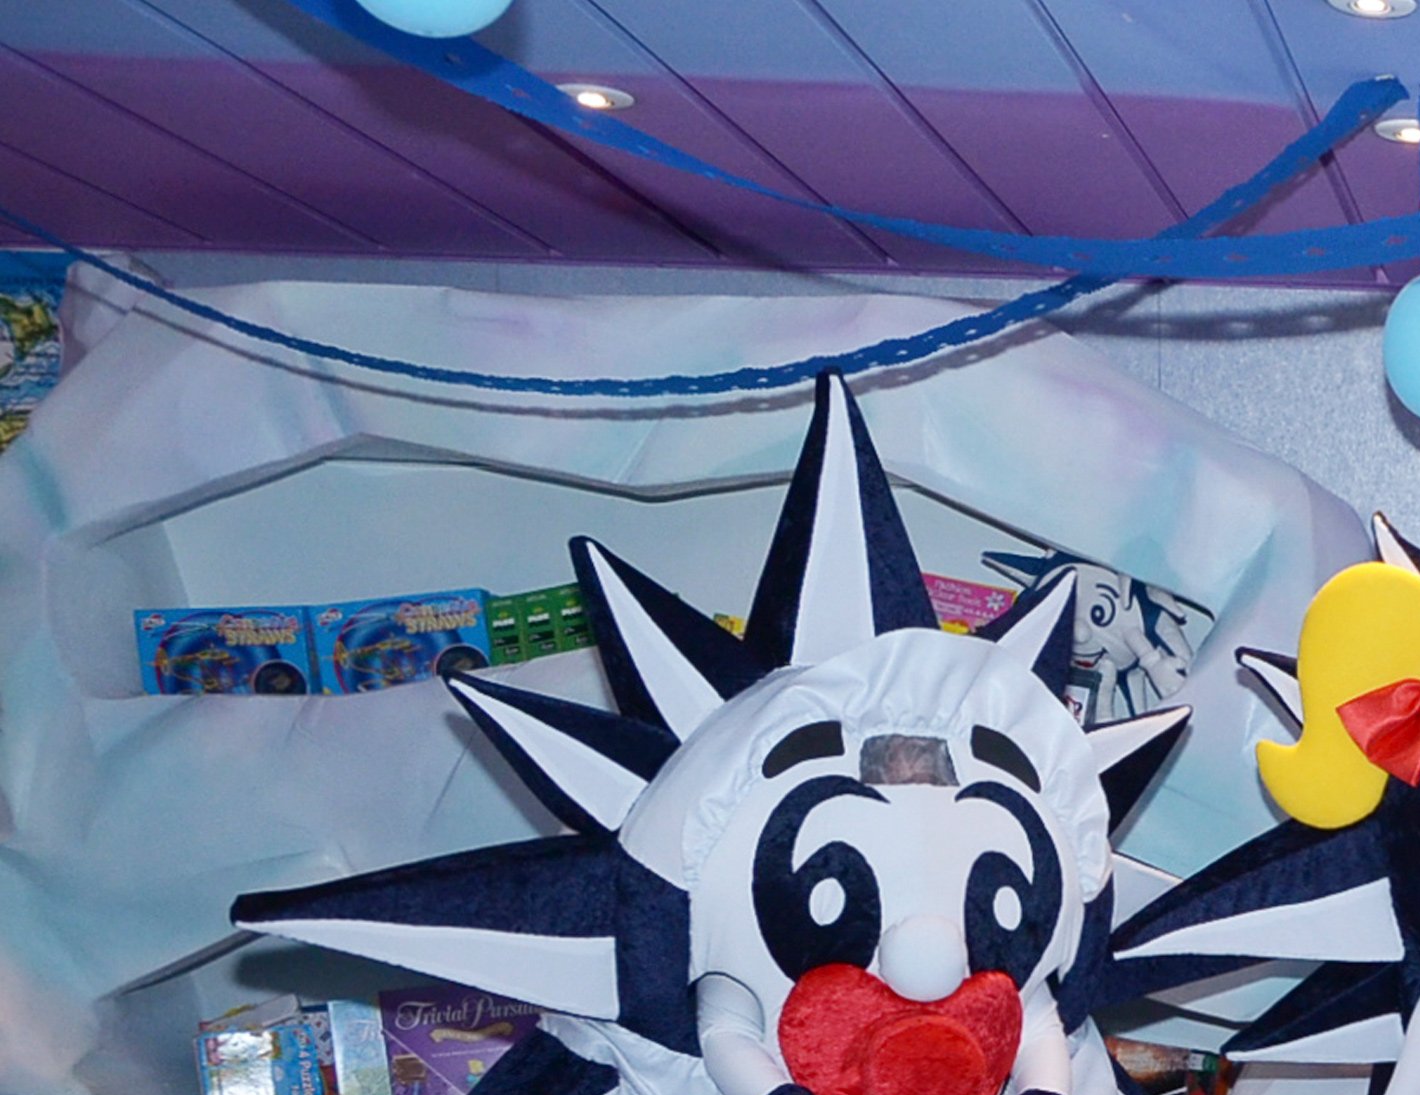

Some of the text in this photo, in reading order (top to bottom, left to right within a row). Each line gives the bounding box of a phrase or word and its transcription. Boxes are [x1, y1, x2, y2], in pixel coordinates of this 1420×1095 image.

[403, 613, 477, 634] STRAWS
[224, 628, 297, 646] STRAWS
[394, 999, 468, 1030] Trivial
